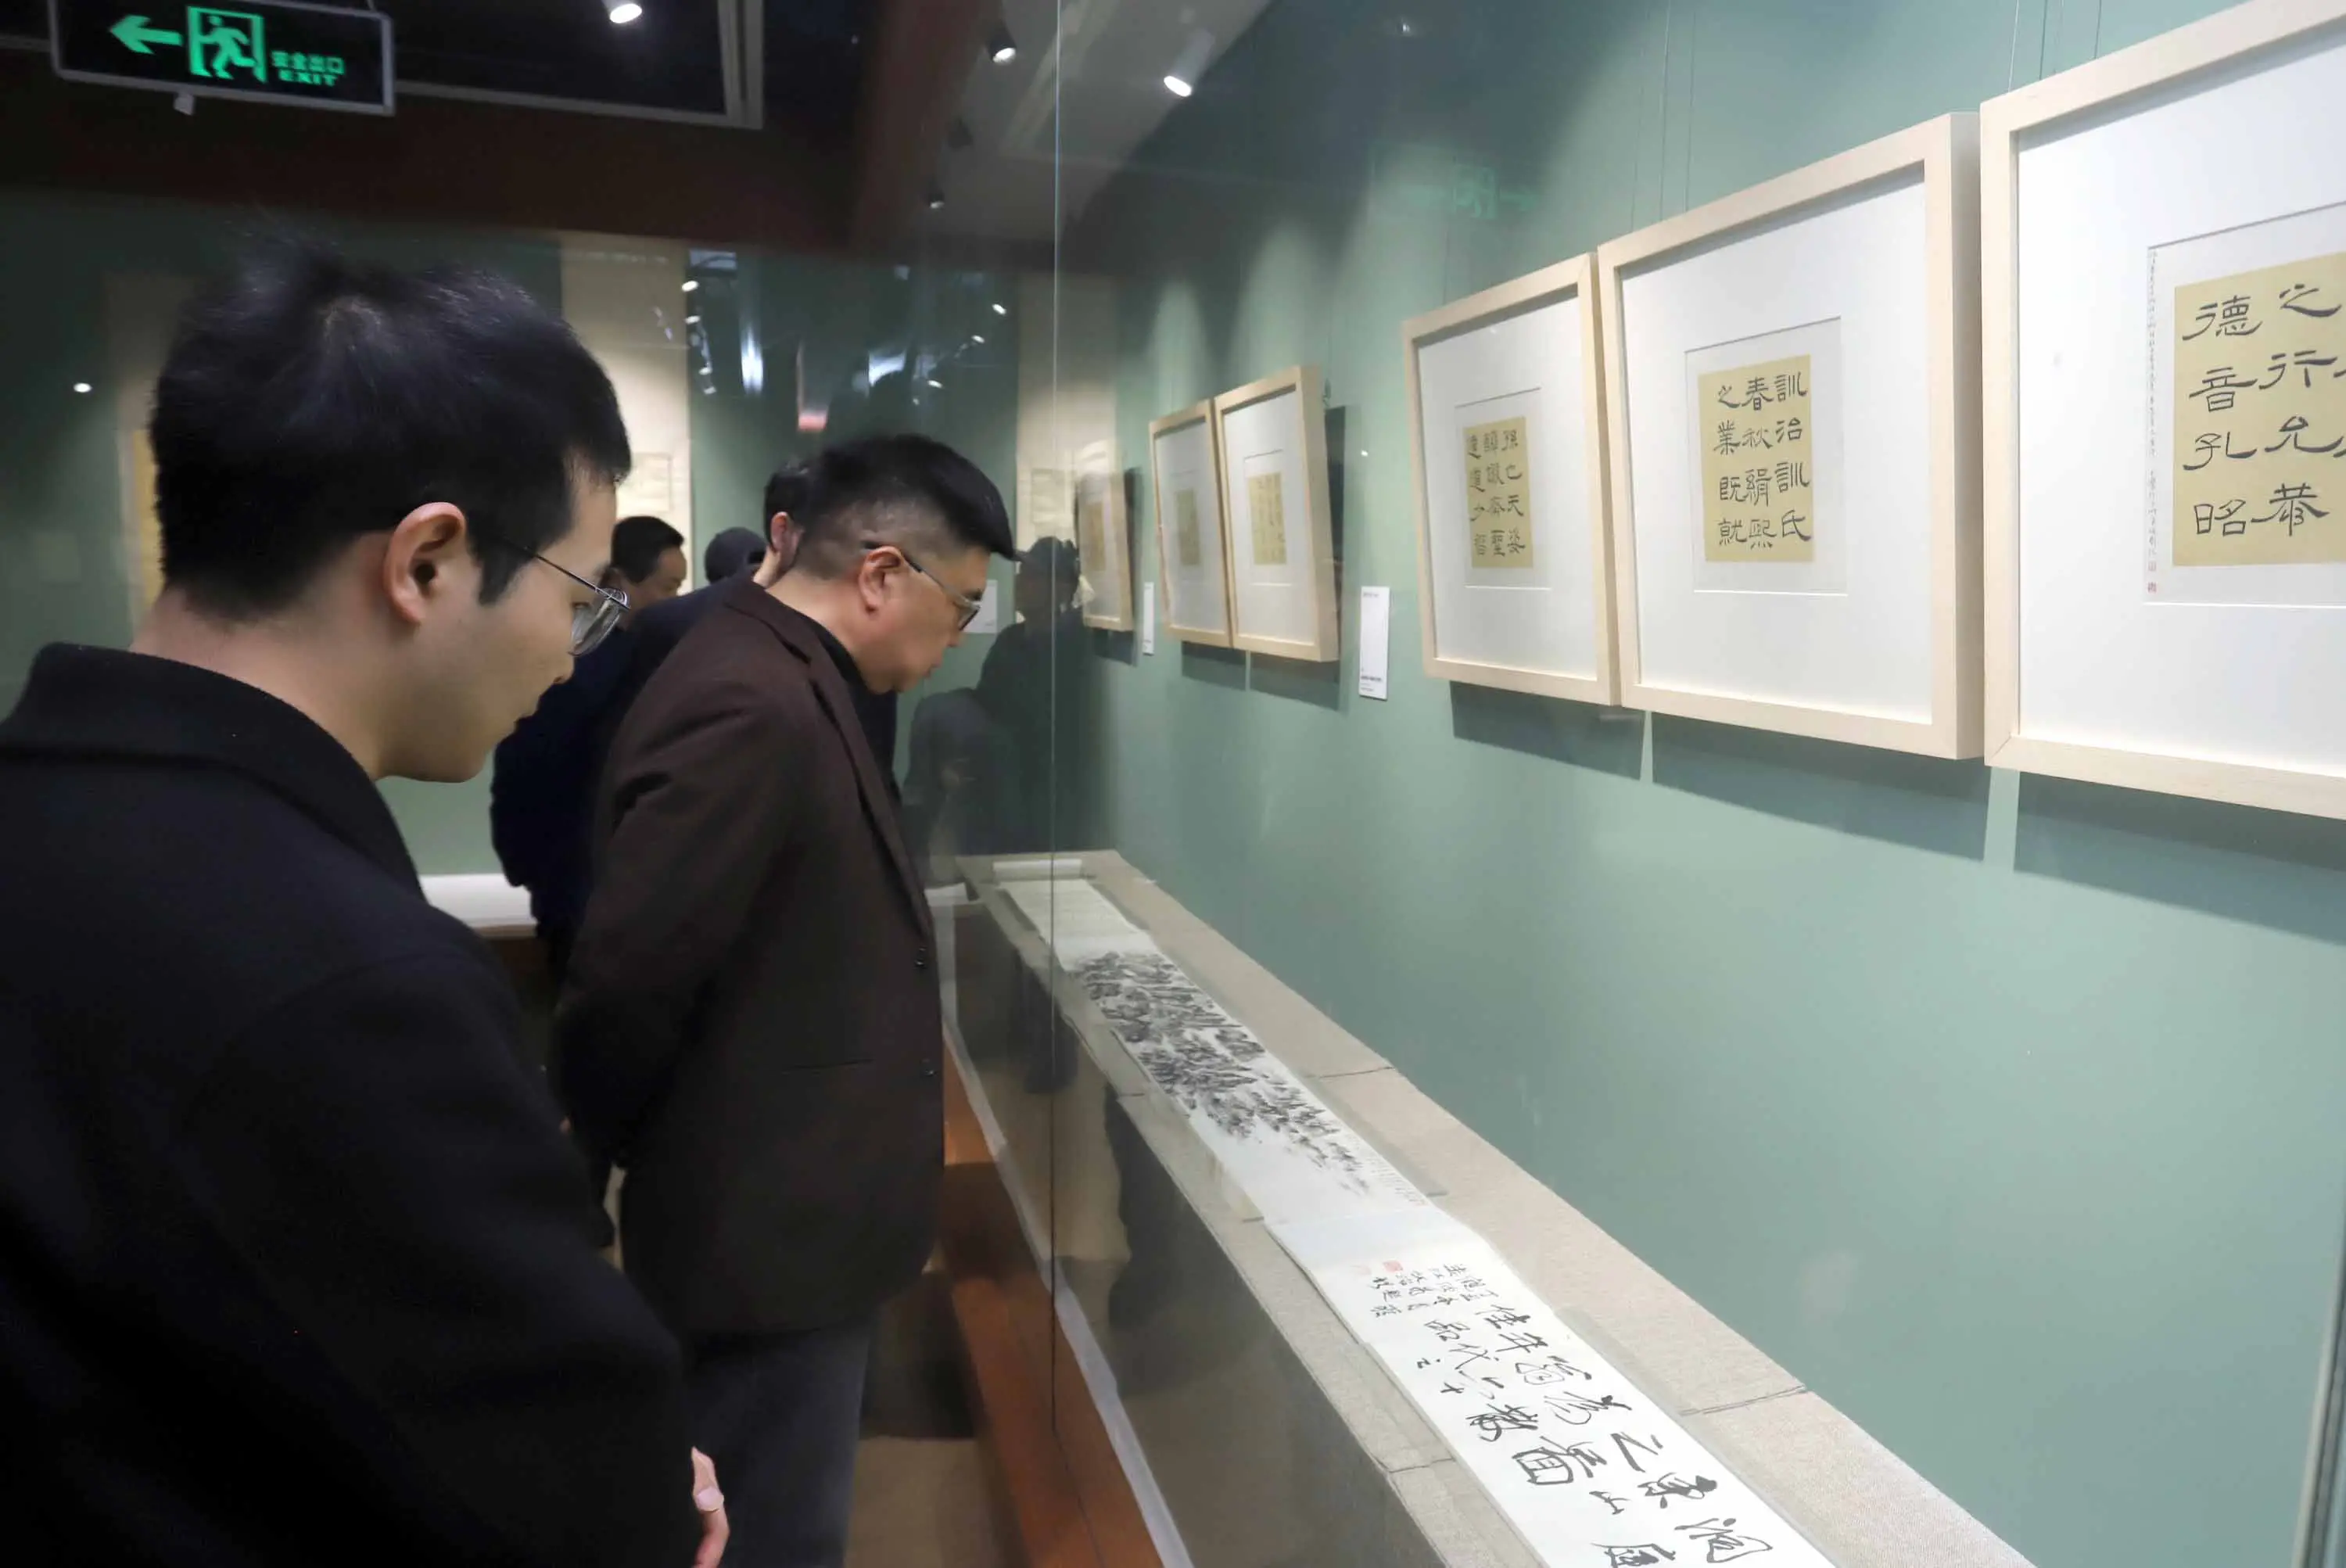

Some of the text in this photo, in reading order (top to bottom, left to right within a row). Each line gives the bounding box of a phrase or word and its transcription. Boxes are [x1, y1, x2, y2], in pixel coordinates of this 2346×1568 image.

[278, 69, 338, 87] EXIT
[2182, 295, 2262, 537] 德音孔昭
